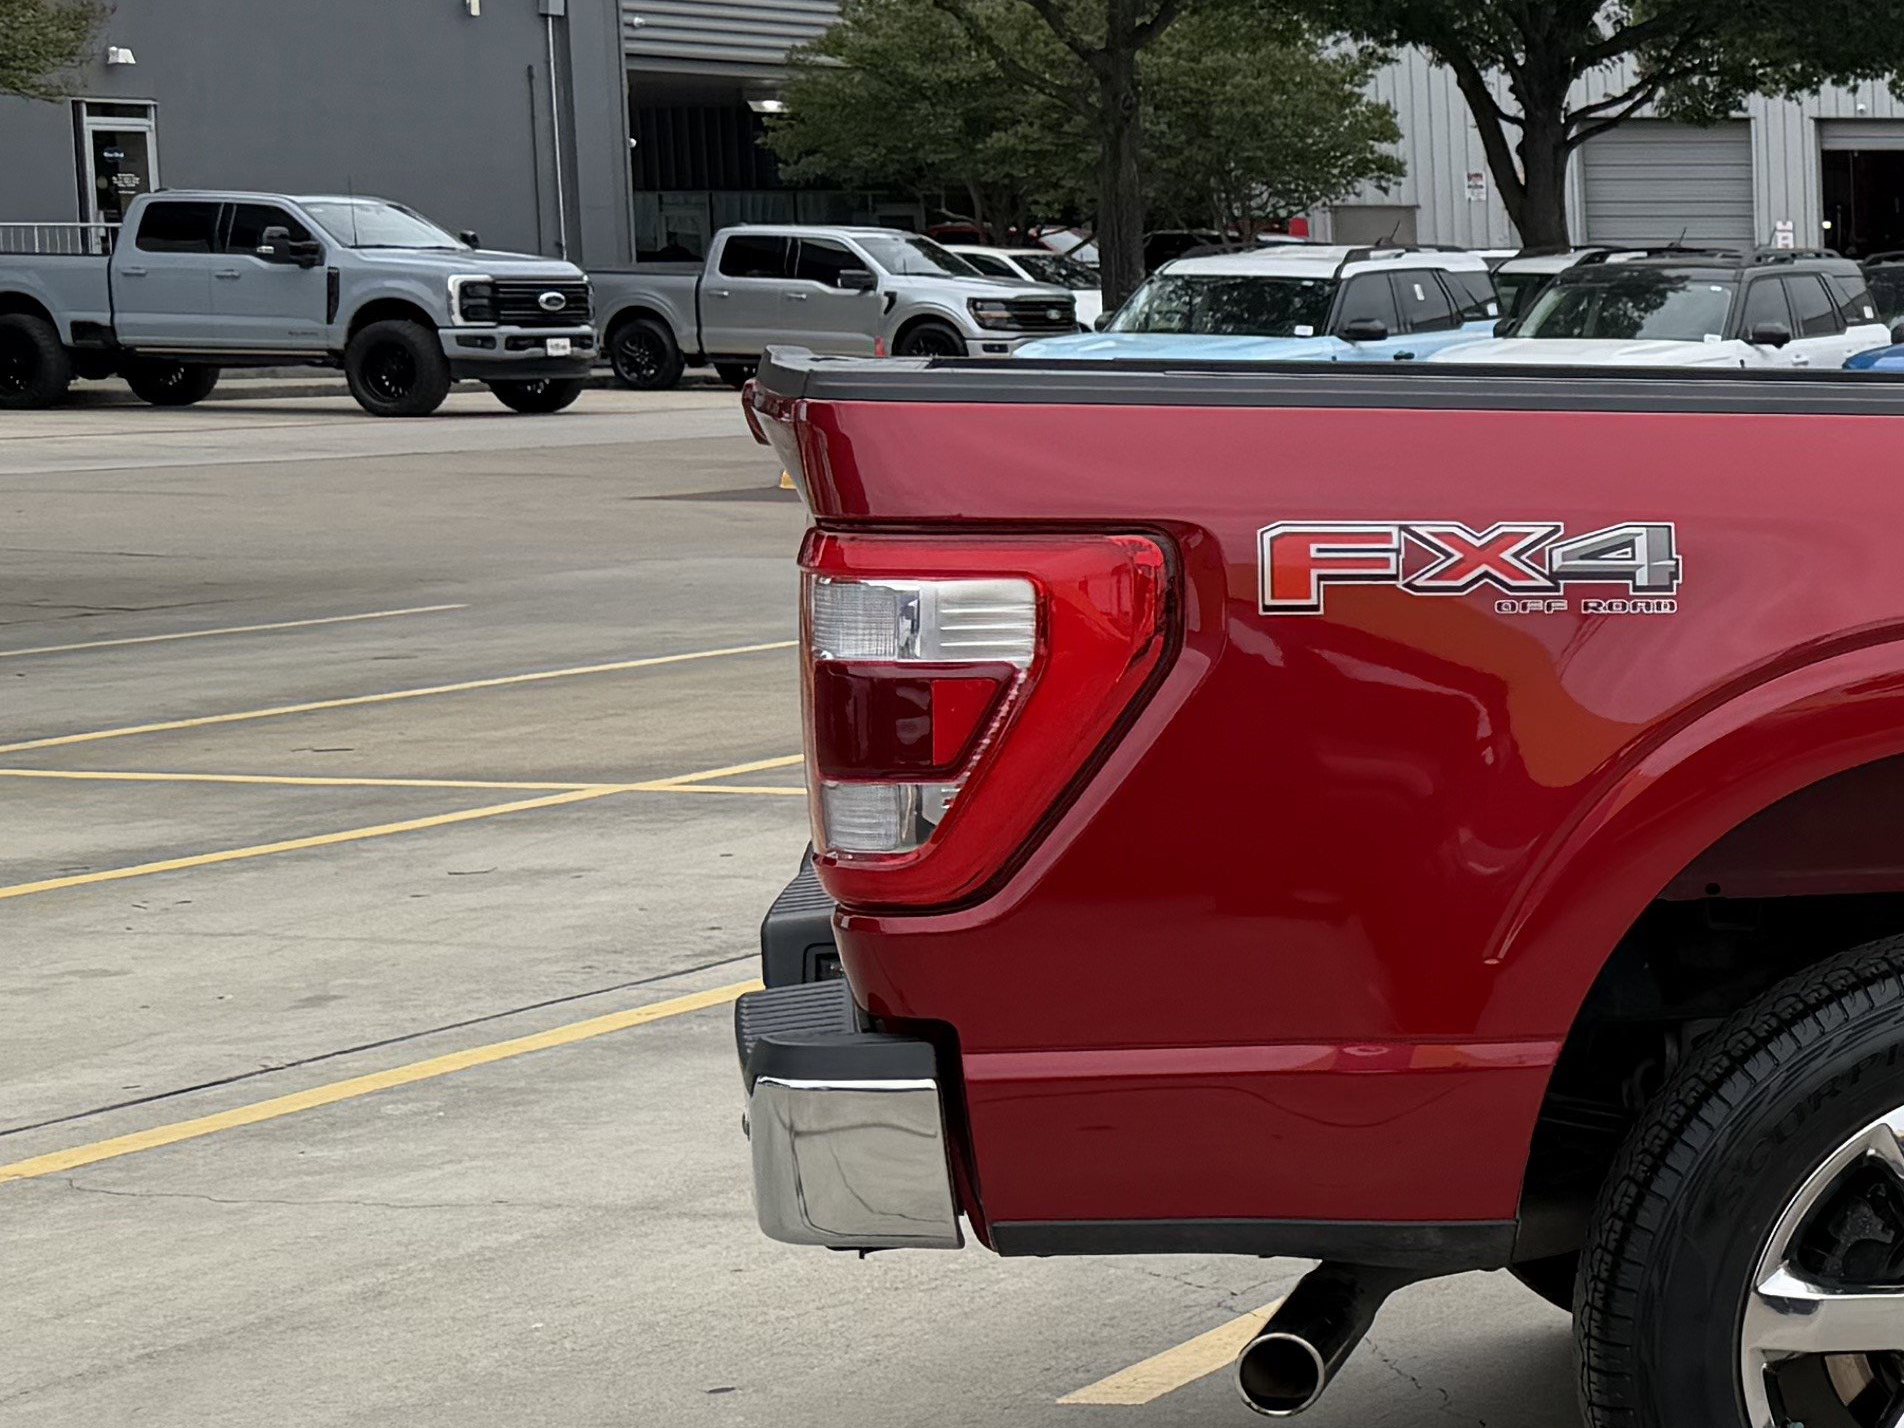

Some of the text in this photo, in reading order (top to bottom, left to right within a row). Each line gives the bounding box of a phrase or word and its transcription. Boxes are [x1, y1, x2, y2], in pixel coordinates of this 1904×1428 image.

[1258, 520, 1682, 615] FX4
[1494, 599, 1678, 614] OFF ROAD
